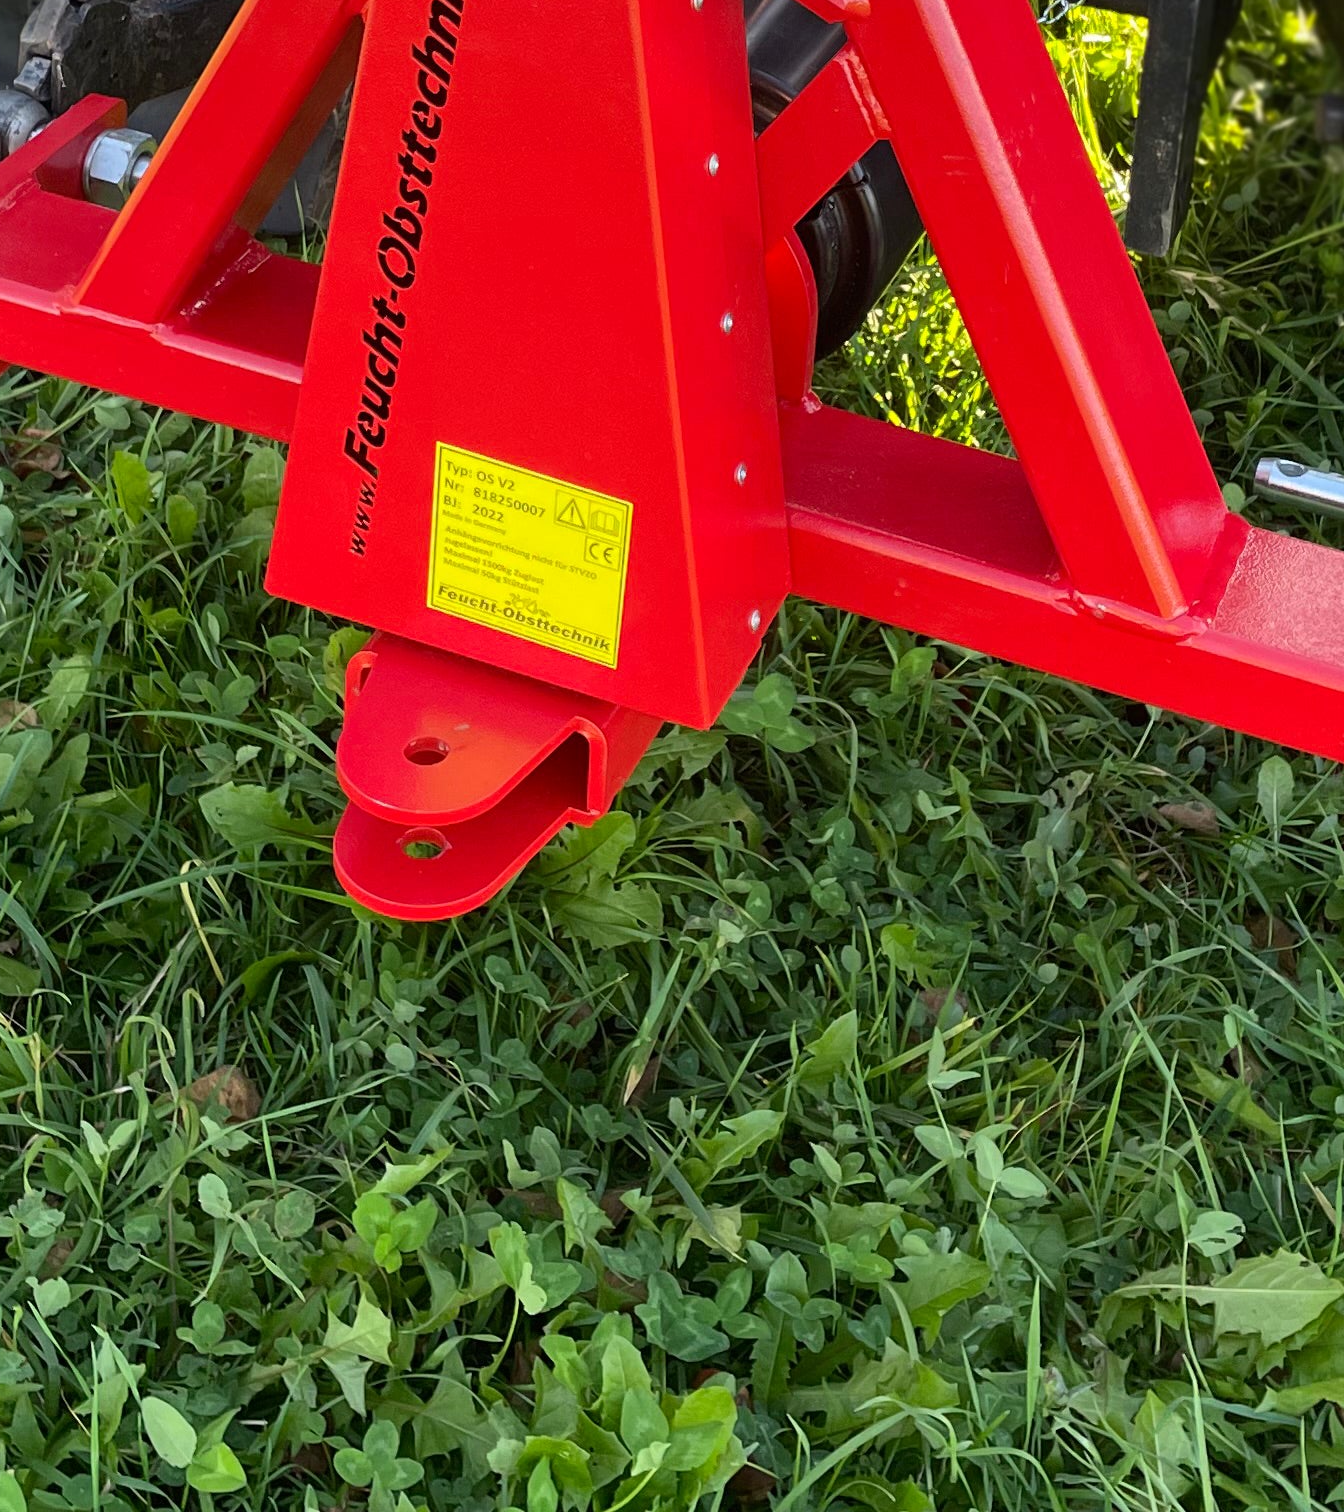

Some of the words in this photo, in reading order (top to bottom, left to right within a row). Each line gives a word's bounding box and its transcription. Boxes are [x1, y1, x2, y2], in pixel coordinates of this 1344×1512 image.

[445, 459, 472, 479] Typ:
[476, 470, 495, 485] OS
[498, 476, 515, 491] V2
[444, 477, 464, 493] Nr:
[473, 486, 546, 518] 818250007
[472, 503, 504, 523] 2022
[589, 542, 614, 564] CE
[437, 585, 611, 652] Feucht-Obsttechnik
